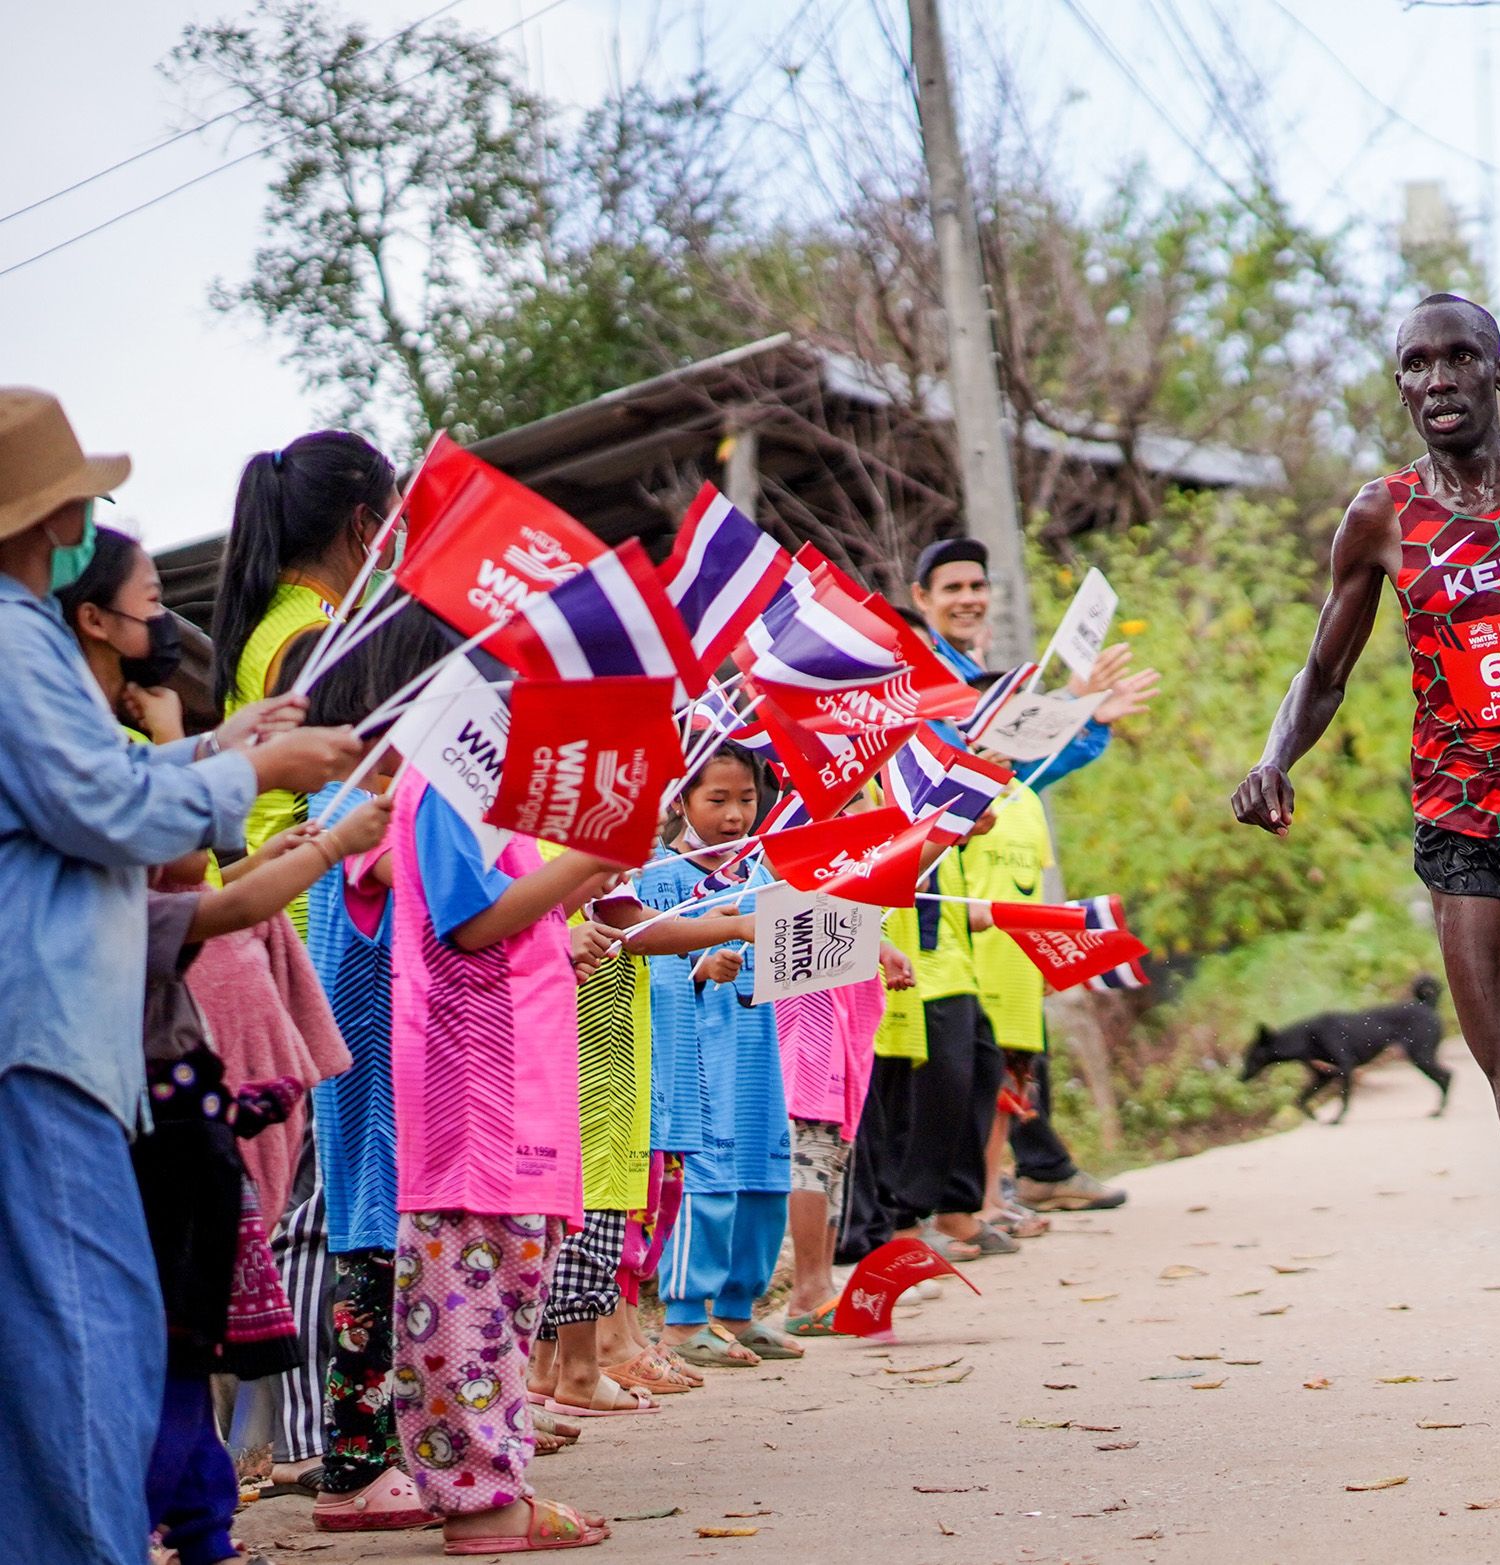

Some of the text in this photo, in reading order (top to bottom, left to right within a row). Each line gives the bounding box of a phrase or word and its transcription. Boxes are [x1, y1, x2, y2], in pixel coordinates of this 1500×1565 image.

[1468, 632, 1498, 645] WMTRC
[515, 746, 555, 831] chiangma
[537, 739, 589, 842] WMTRC
[770, 918, 791, 984] chiangmai
[792, 909, 814, 982] WMTRC
[1044, 931, 1088, 964] MTRC
